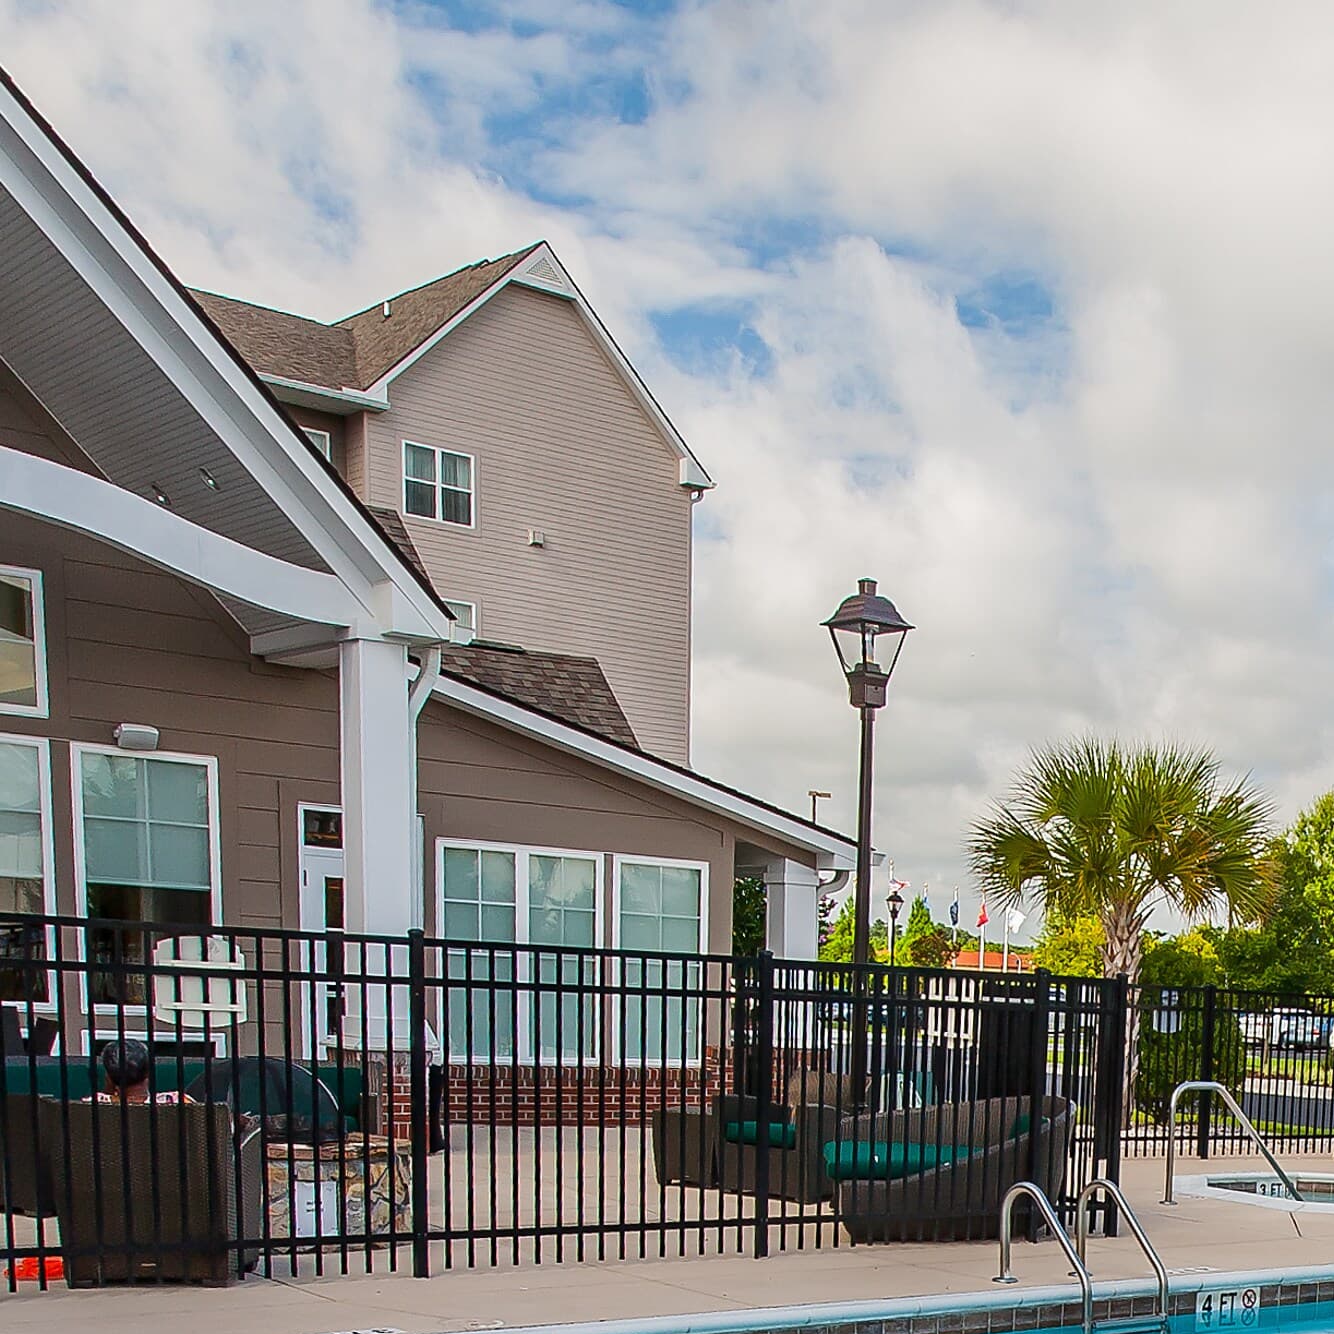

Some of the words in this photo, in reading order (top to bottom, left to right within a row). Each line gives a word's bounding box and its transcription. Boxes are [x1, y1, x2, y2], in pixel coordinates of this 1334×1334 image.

[1259, 1183, 1266, 1195] 3
[1202, 1294, 1212, 1311] 4
[1220, 1292, 1237, 1311] FT
